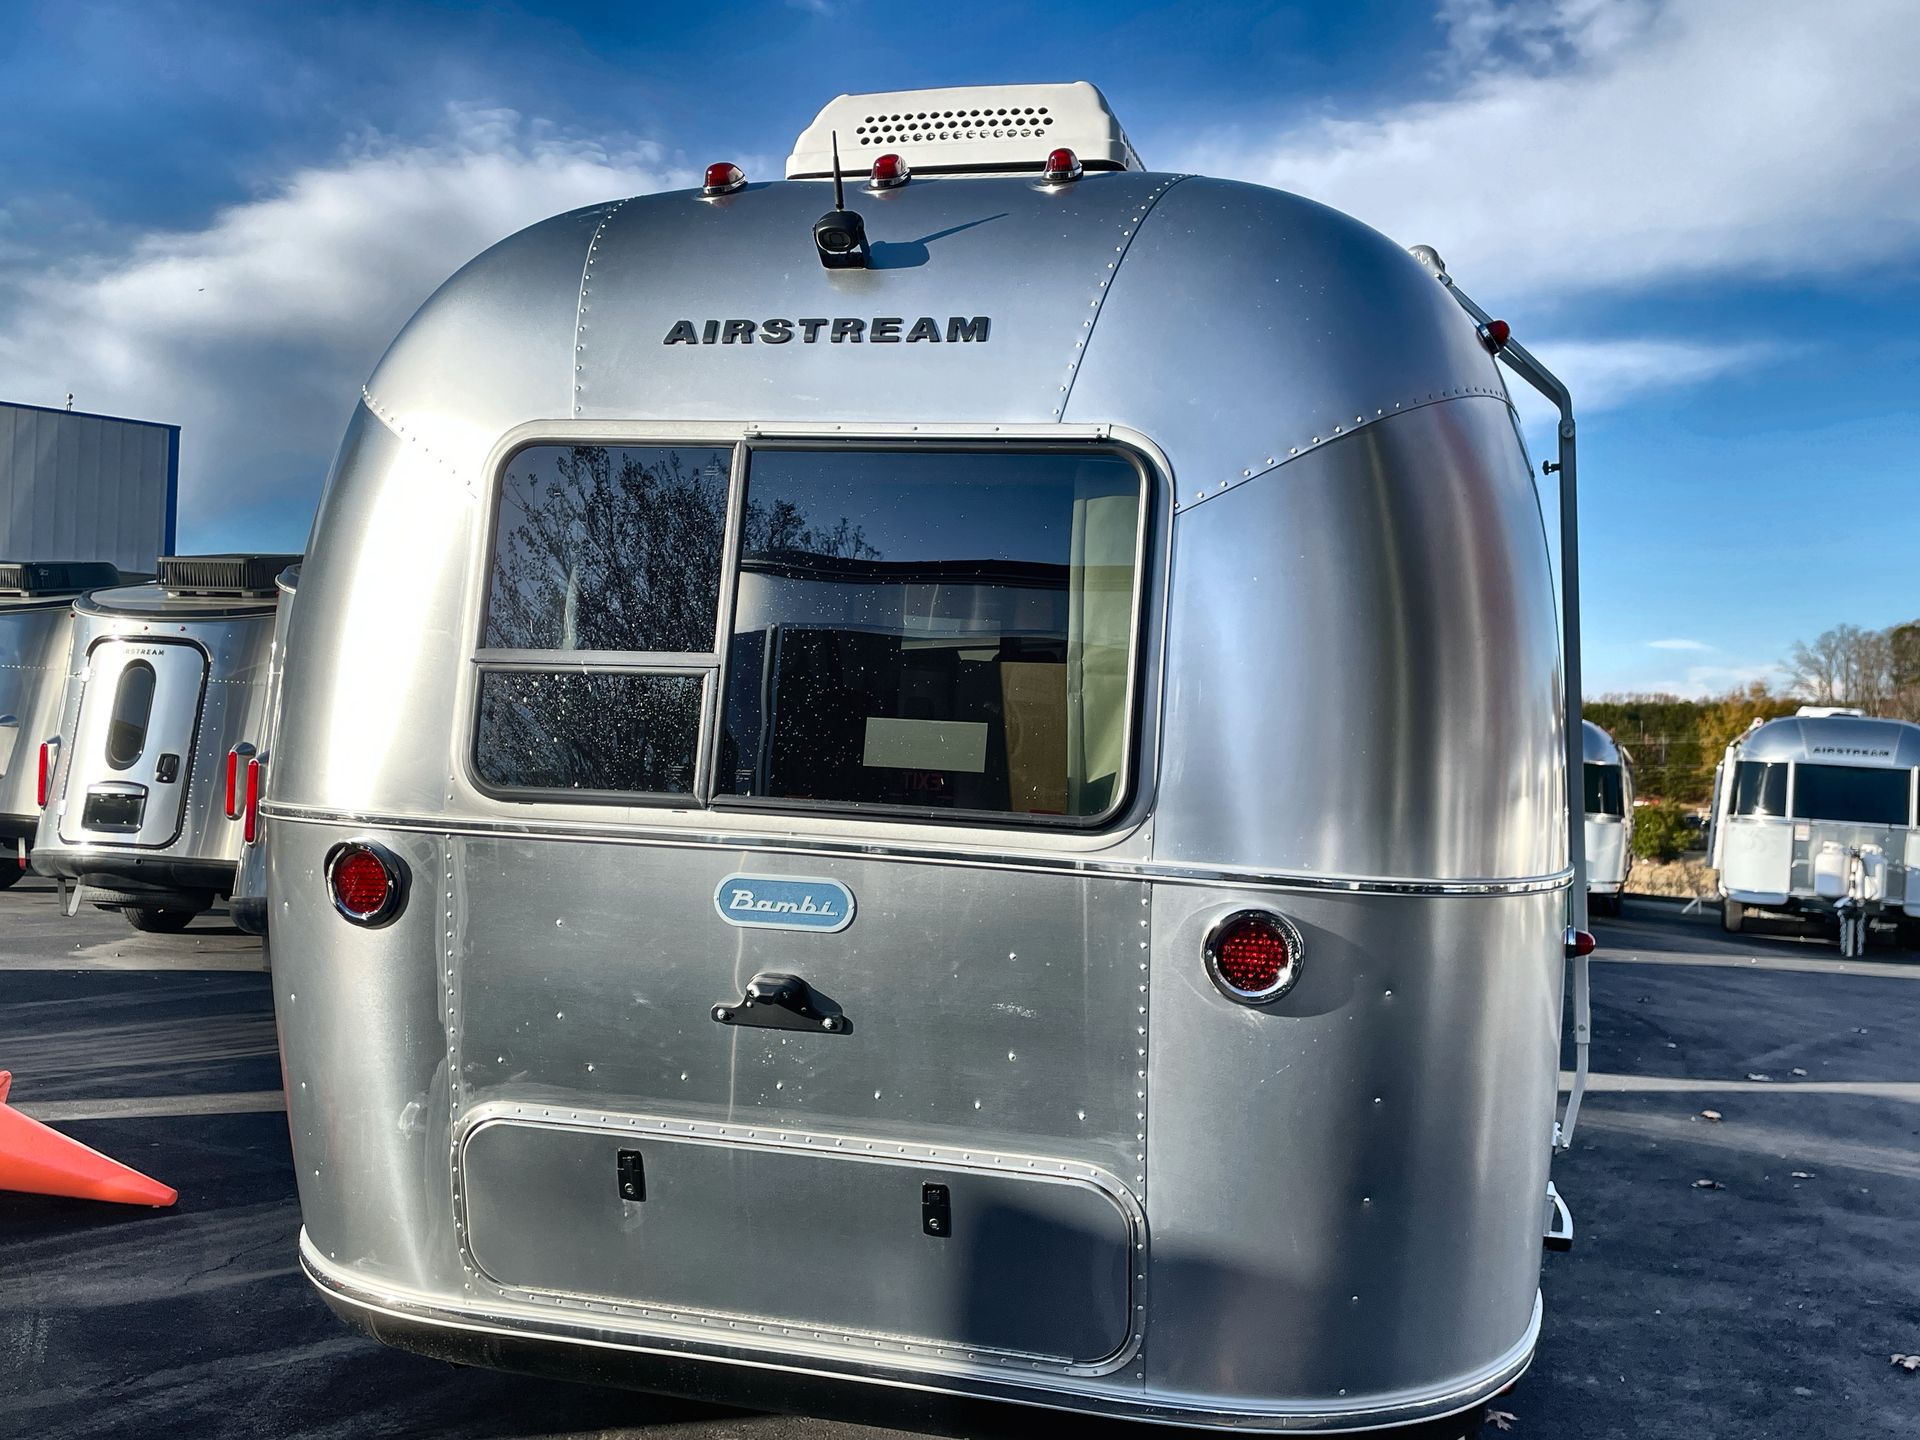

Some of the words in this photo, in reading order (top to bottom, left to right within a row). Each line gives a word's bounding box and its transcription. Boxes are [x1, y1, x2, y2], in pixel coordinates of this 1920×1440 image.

[663, 316, 989, 345] AIRSTREAM
[1812, 746, 1889, 757] AIRSTREAM
[729, 889, 839, 916] Bambi
